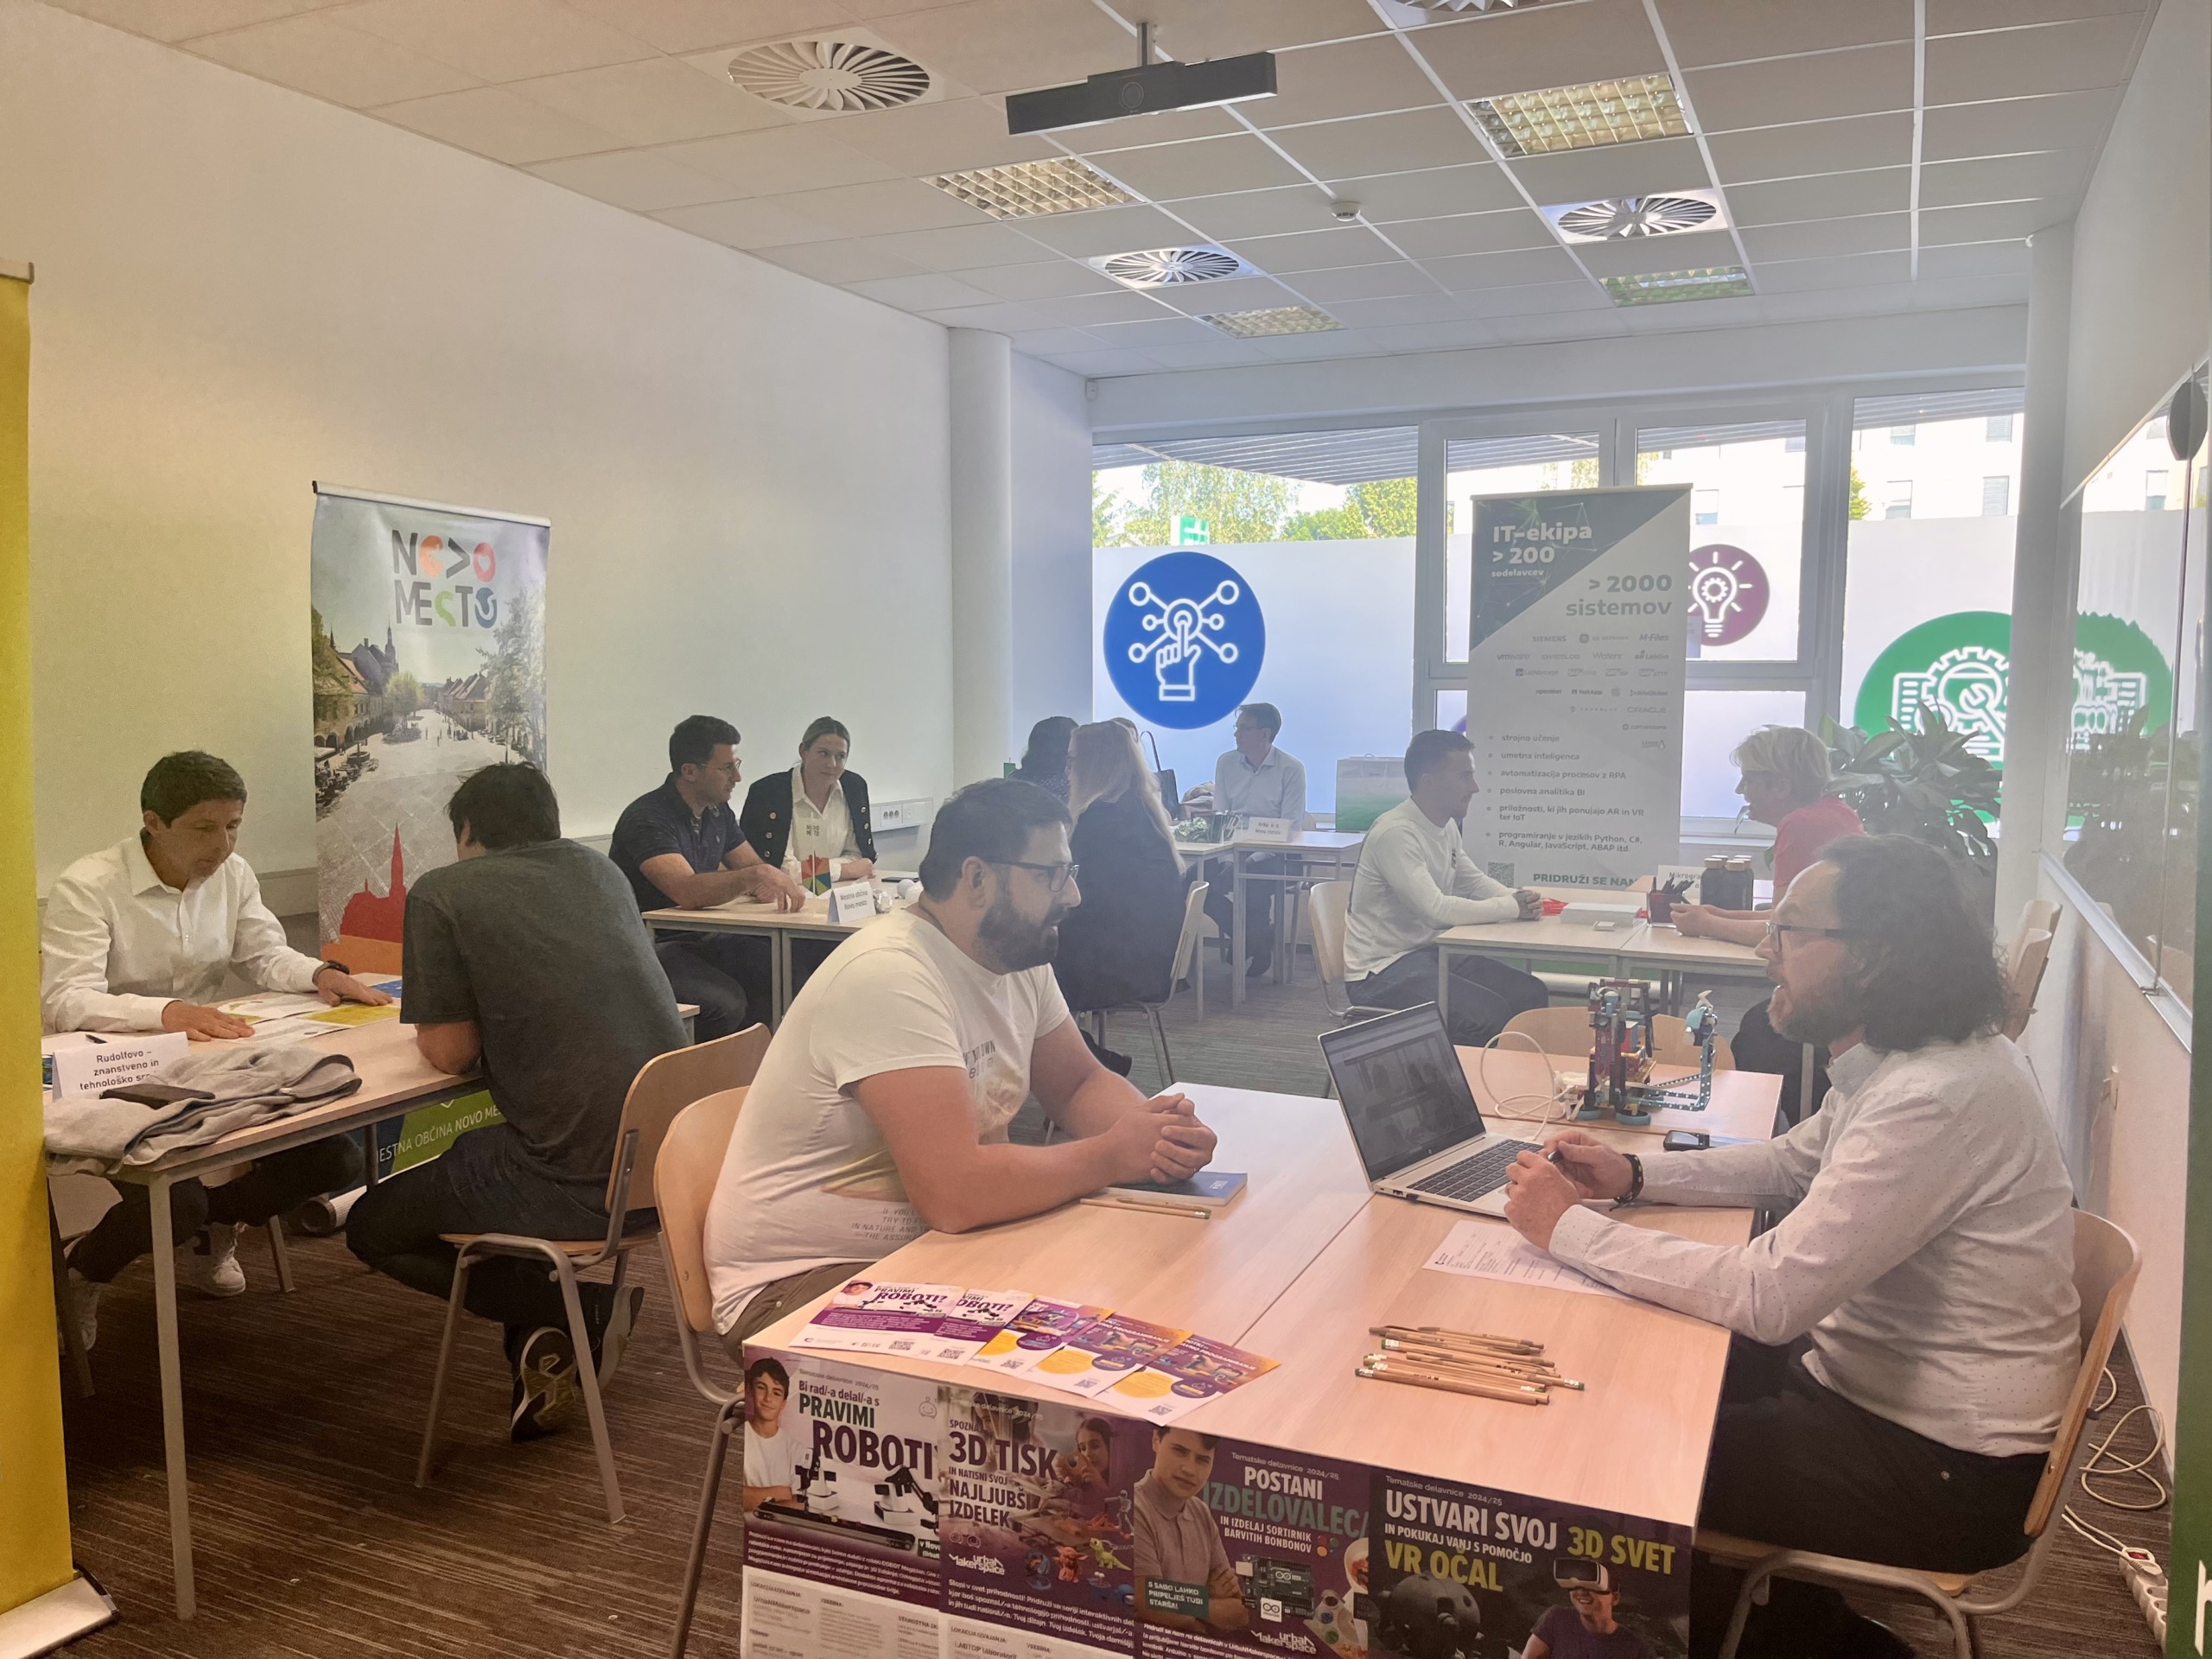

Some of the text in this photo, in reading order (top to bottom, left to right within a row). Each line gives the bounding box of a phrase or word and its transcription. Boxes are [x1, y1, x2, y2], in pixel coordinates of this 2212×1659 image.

[1493, 522, 1592, 544] IT-ekipa
[1509, 546, 1555, 563] 200
[1491, 569, 1545, 577] sodelavcev
[1606, 575, 1673, 593] 2000
[394, 580, 498, 628] MESTO
[1566, 599, 1673, 616] sistemov
[1639, 633, 1669, 642] M-Files
[1535, 753, 1580, 761] inteligenca
[1500, 770, 1560, 779] avtomatizacija
[1499, 804, 1546, 813] priložnosti,
[1556, 805, 1567, 814] jih
[1569, 807, 1605, 816] ponujajo
[1499, 831, 1556, 841] programiranje
[1565, 833, 1592, 842] jezikih
[1594, 835, 1627, 843] Python,
[1509, 841, 1544, 849] Angular,
[1545, 842, 1589, 851] JavaScript,
[1533, 873, 1590, 885] PRIDRUŽI
[1592, 876, 1607, 886] SE
[1669, 871, 1701, 881] Mikrogra
[96, 1050, 144, 1064] Rudolfovo
[93, 1061, 148, 1077] znanstveno
[150, 1058, 159, 1067] in
[79, 1074, 133, 1090] tehnološko
[377, 1110, 482, 1163] ESTNA OBČINA NOVO
[862, 1224, 896, 1232] NATURE
[875, 1291, 948, 1303] ROBOTI?
[957, 1300, 1014, 1312] OBOTI?
[798, 1380, 880, 1407] Bi rad/-a delal/-a s
[799, 1393, 875, 1428] PRAVIMI
[812, 1420, 938, 1480] ROBOTI
[949, 1431, 1058, 1482] 3D TISK
[1231, 1452, 1267, 1465] Tematske
[1267, 1459, 1304, 1472] delavnice
[949, 1466, 1007, 1486] IN NATISNI SVOJ
[1244, 1466, 1324, 1501] POSTANI
[950, 1479, 1033, 1511] NAJLJUBŠI
[1385, 1475, 1503, 1507] Tematske delavnice 2024/25
[950, 1500, 1011, 1529] IZDELEK
[1220, 1516, 1312, 1543] IN IZDELAJ SORTIRNIK
[1386, 1488, 1676, 1576] USTVARI SVOJ 3D SVET
[1224, 1528, 1312, 1554] BARVITIH BONBONOV
[1384, 1522, 1533, 1564] IN POKUKAJ VANJ S POMOČJO
[1384, 1540, 1503, 1592] VR OČAL
